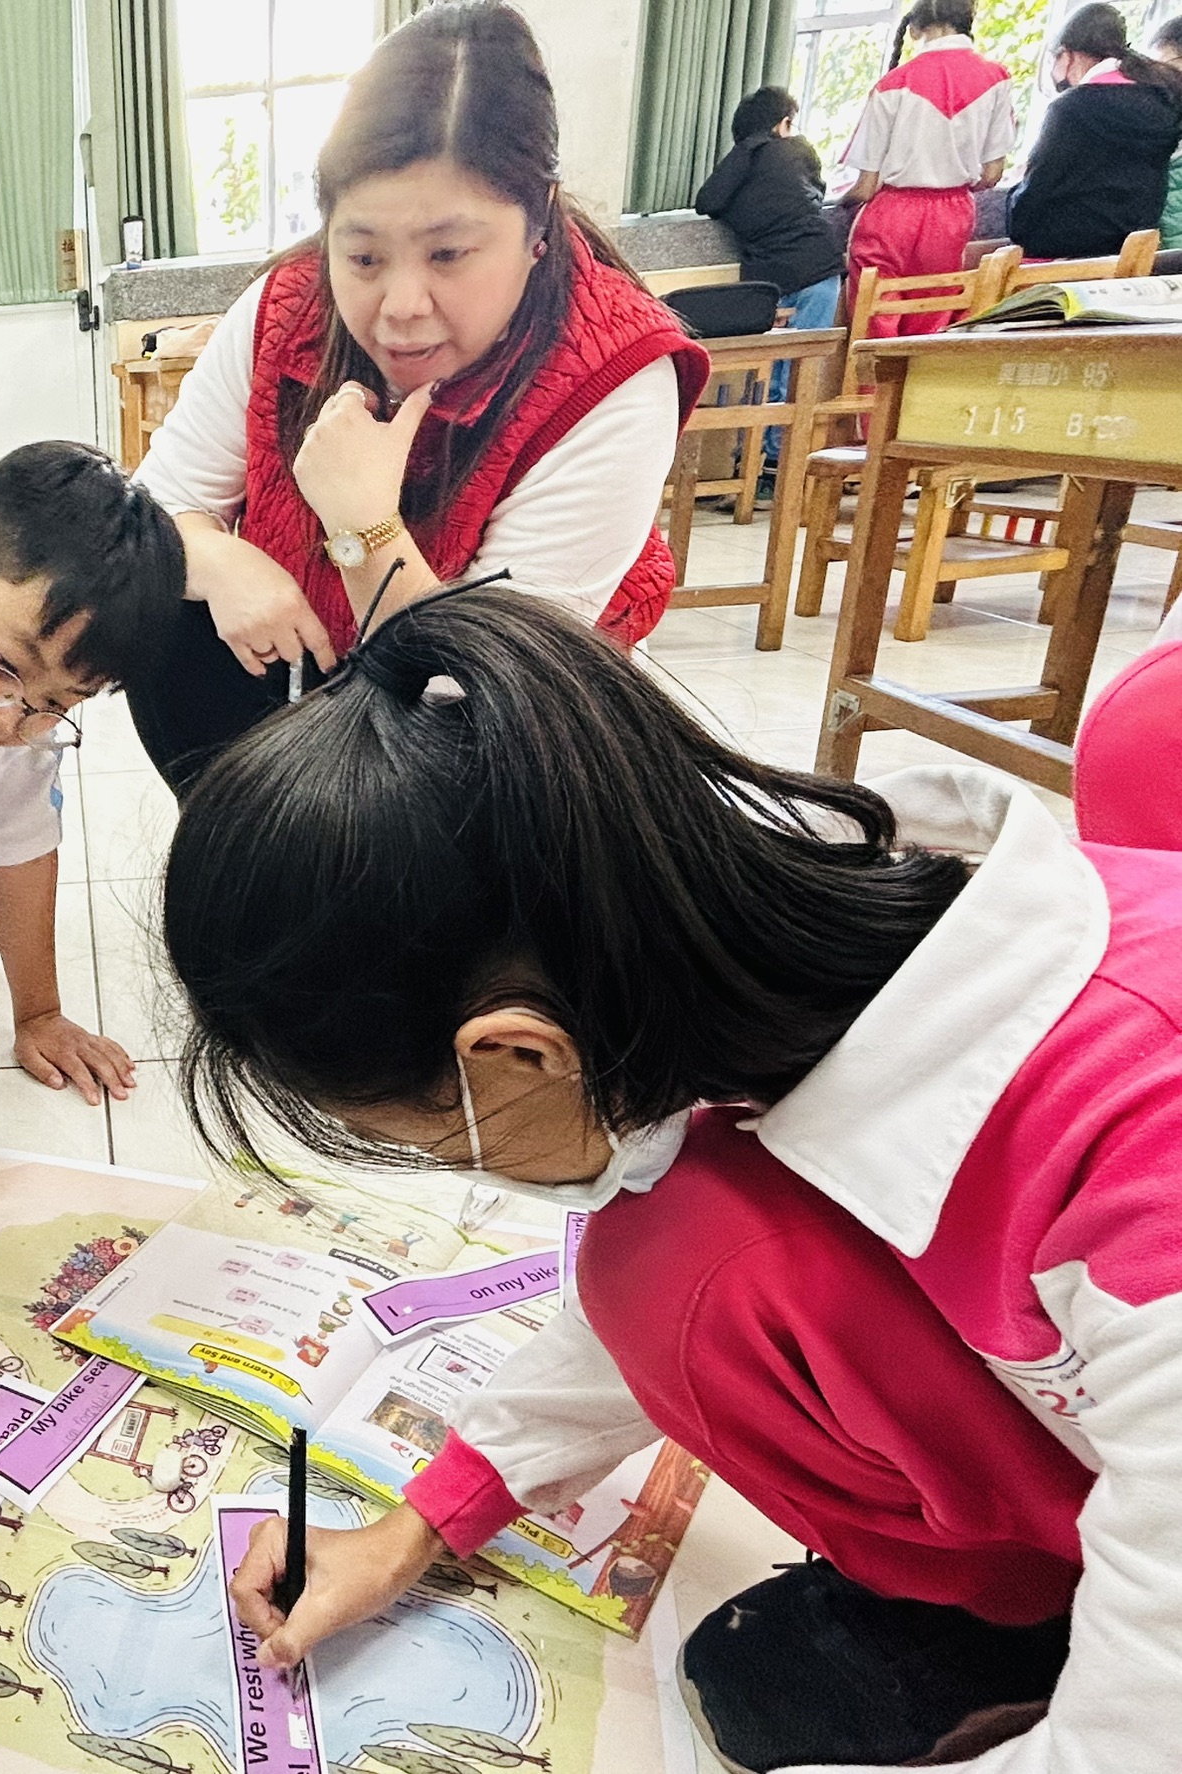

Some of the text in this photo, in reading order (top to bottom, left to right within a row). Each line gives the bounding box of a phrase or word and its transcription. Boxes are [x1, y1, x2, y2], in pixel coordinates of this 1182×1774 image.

[469, 1285, 495, 1300] on
[497, 1276, 525, 1293] my
[525, 1266, 559, 1283] bike
[197, 1345, 275, 1379] Learn and Say
[30, 1360, 109, 1436] My bike sea
[511, 1520, 540, 1538] Pict
[242, 1666, 264, 1712] rest
[246, 1721, 269, 1764] We
